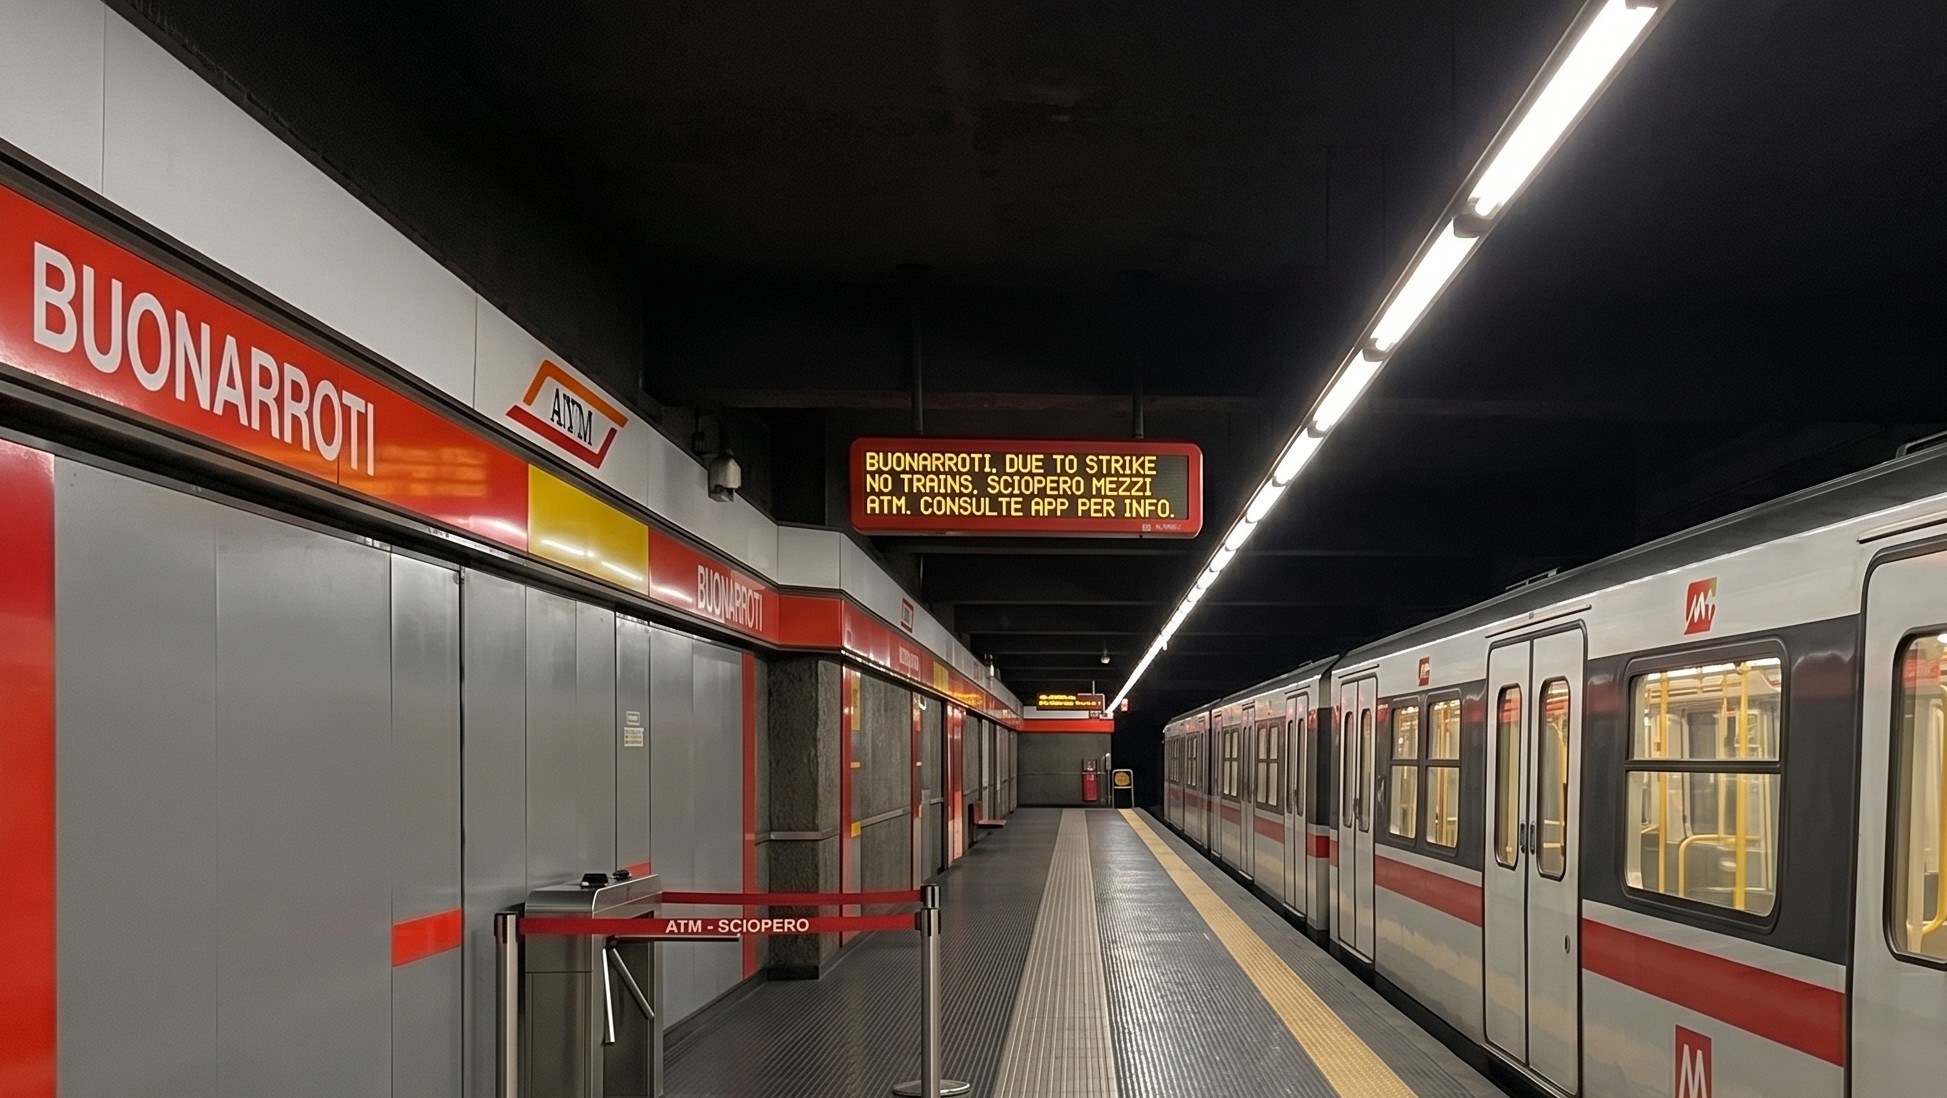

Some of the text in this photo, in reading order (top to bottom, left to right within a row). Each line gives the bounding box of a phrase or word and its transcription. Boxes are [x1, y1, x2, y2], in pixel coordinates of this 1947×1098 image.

[34, 241, 375, 477] BUONARROTI
[866, 452, 1157, 475] BUONARROTI. DUE TO STRIKE
[866, 473, 1152, 496] NO TRAINS. SCIOPERO MEZZI
[866, 495, 1175, 518] ATM. CONSULTE APP PER INFO.
[697, 564, 763, 632] BUONARROTI
[665, 919, 702, 934] ATM
[718, 918, 810, 933] SCIOPERO
[1678, 1043, 1708, 1098] M
